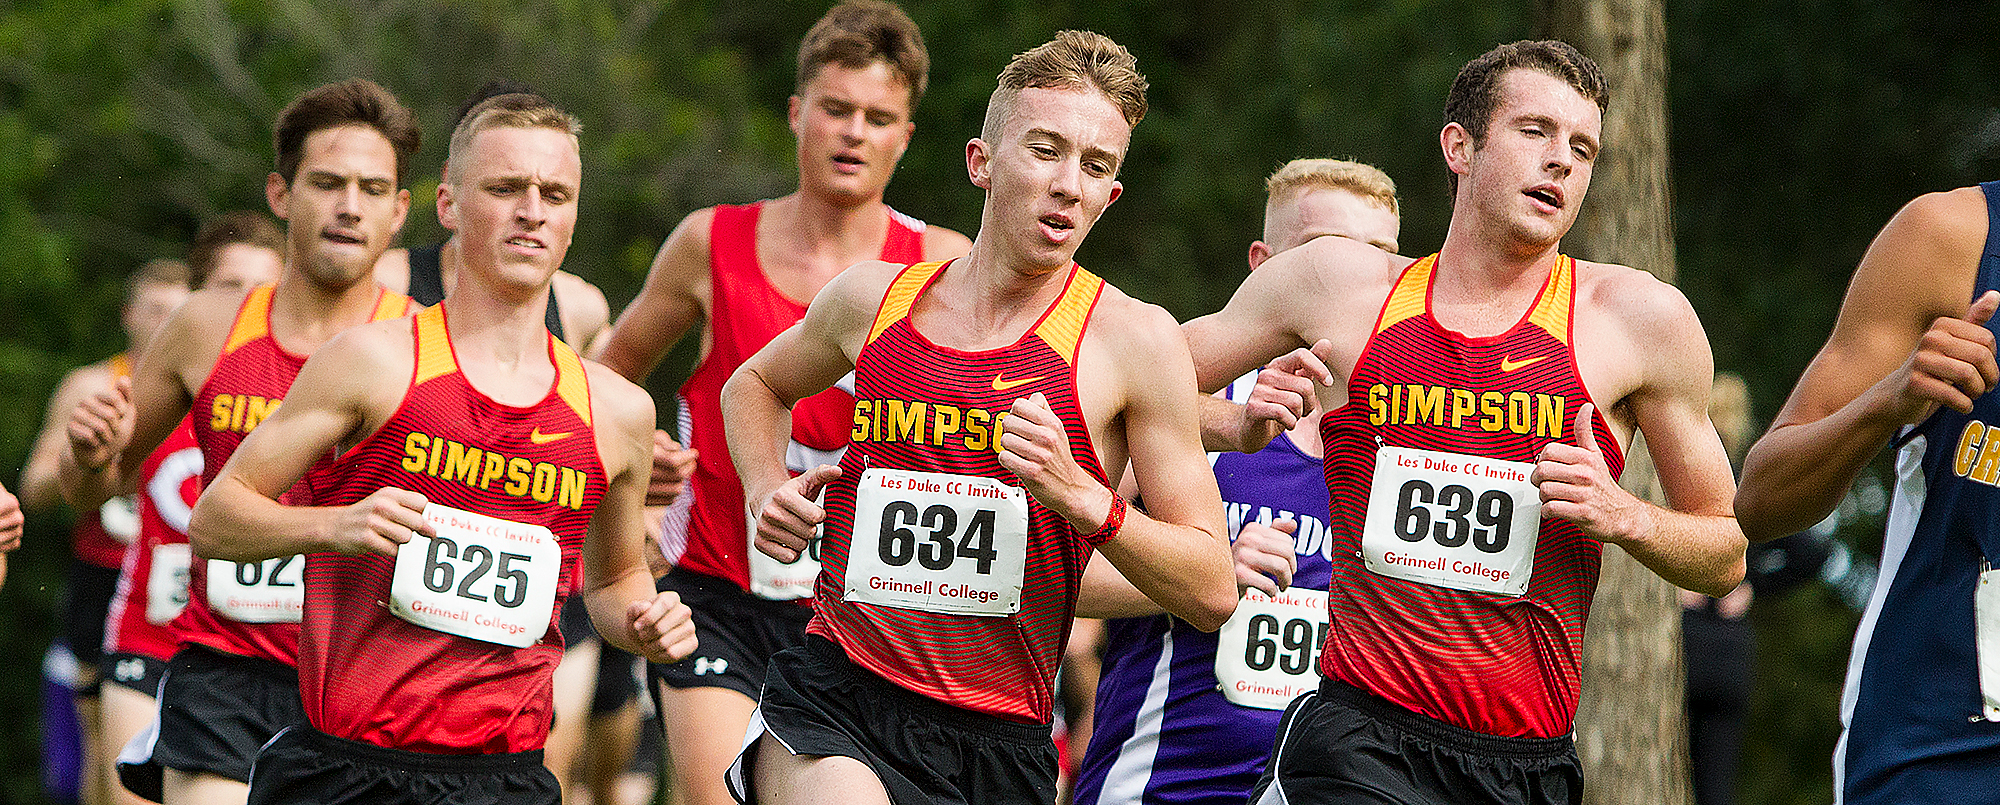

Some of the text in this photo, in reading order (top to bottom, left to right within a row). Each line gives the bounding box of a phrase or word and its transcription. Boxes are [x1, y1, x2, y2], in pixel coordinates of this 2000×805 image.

[1368, 383, 1565, 439] SIMPSON
[1397, 455, 1525, 482] Les Duke CC Invite
[1954, 420, 2000, 488] GR
[401, 431, 588, 511] SIMPSON
[881, 476, 1008, 500] Les Duke CC Invite
[427, 511, 541, 544] Les Duke CC Invite
[1394, 479, 1514, 553] 639
[878, 501, 997, 575] 634
[423, 536, 532, 608] 625
[1384, 552, 1446, 571] Grinnell
[1452, 561, 1510, 581] College
[869, 576, 999, 603] Grinnell College
[1306, 597, 1317, 608] CC
[411, 600, 526, 634] Grinnell College
[1236, 680, 1291, 697] Grinnell
